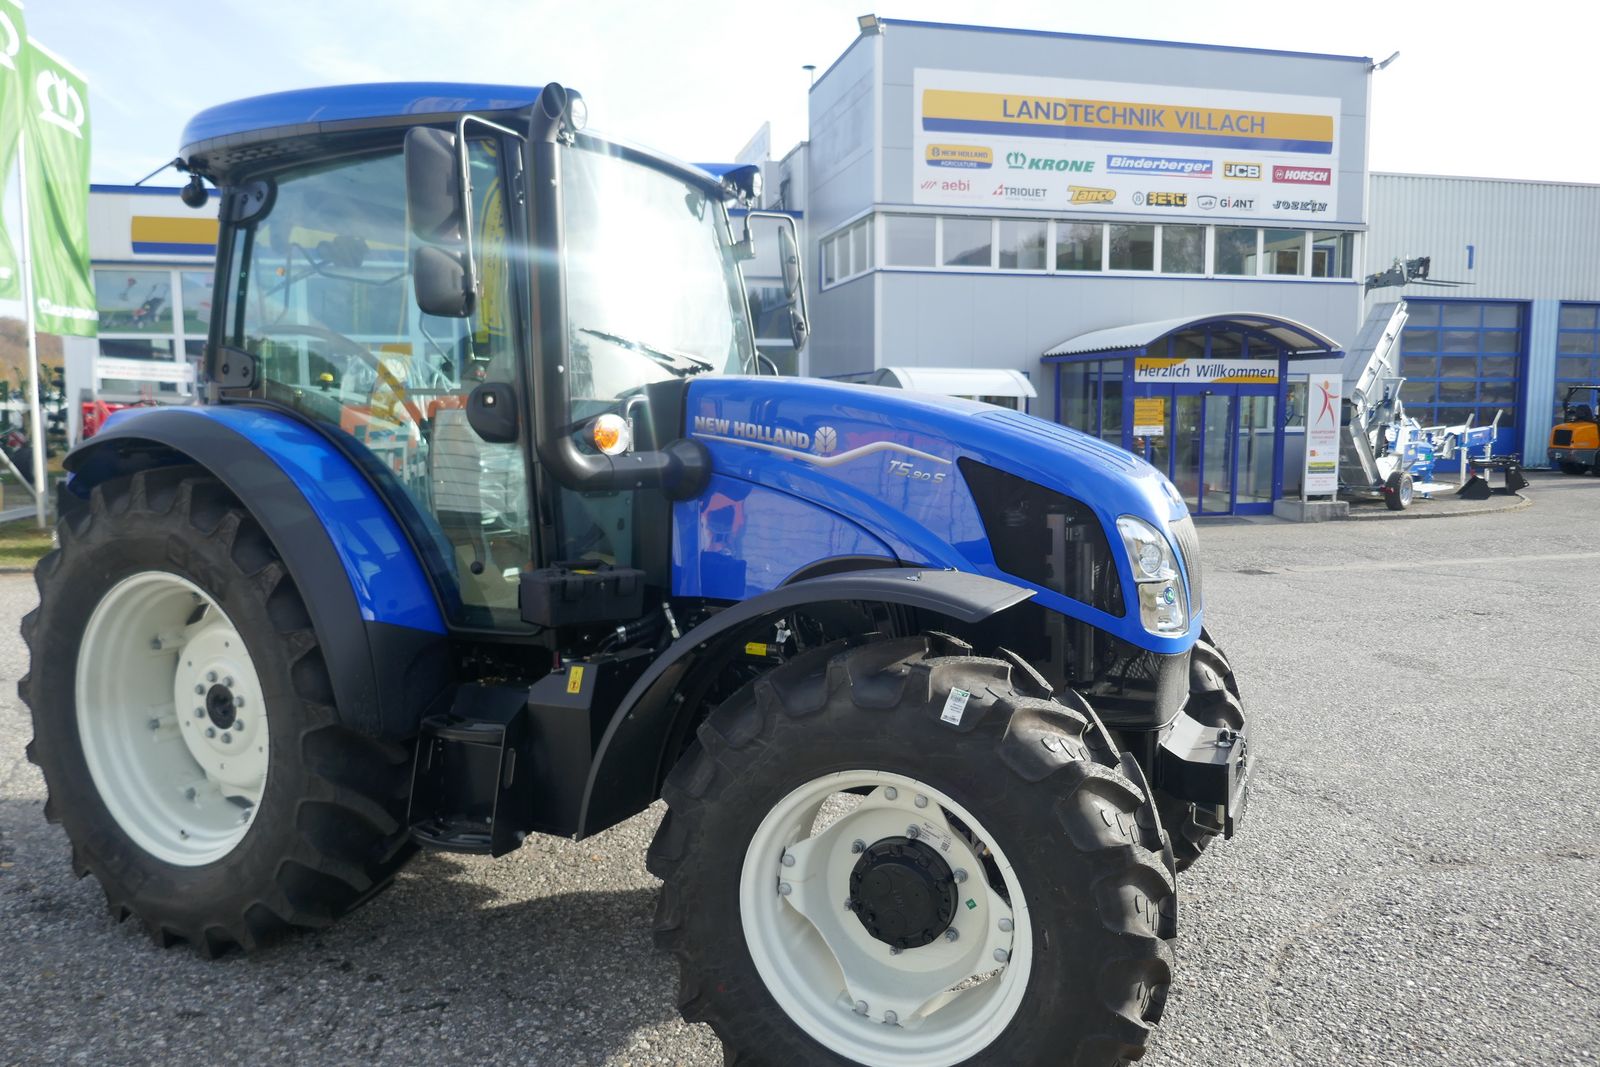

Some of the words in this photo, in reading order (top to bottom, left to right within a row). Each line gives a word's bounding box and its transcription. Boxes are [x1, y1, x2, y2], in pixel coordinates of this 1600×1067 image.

[1002, 99, 1165, 128] LANDTECHNIK
[1174, 110, 1265, 134] VILLACH
[958, 151, 988, 159] HOLLAND
[1028, 158, 1095, 173] KRONE
[1110, 157, 1210, 174] Binderberger
[1224, 163, 1261, 179] JCB
[1284, 169, 1329, 182] HORSCH
[941, 179, 970, 191] aebi
[1067, 184, 1117, 205] Tanco
[1466, 245, 1475, 269] 1
[1138, 364, 1190, 378] Herzlich
[1196, 364, 1276, 379] Willkommen
[694, 415, 730, 435] NEW
[734, 421, 811, 449] HOLLAND
[887, 460, 931, 480] T5.90
[932, 472, 947, 484] S
